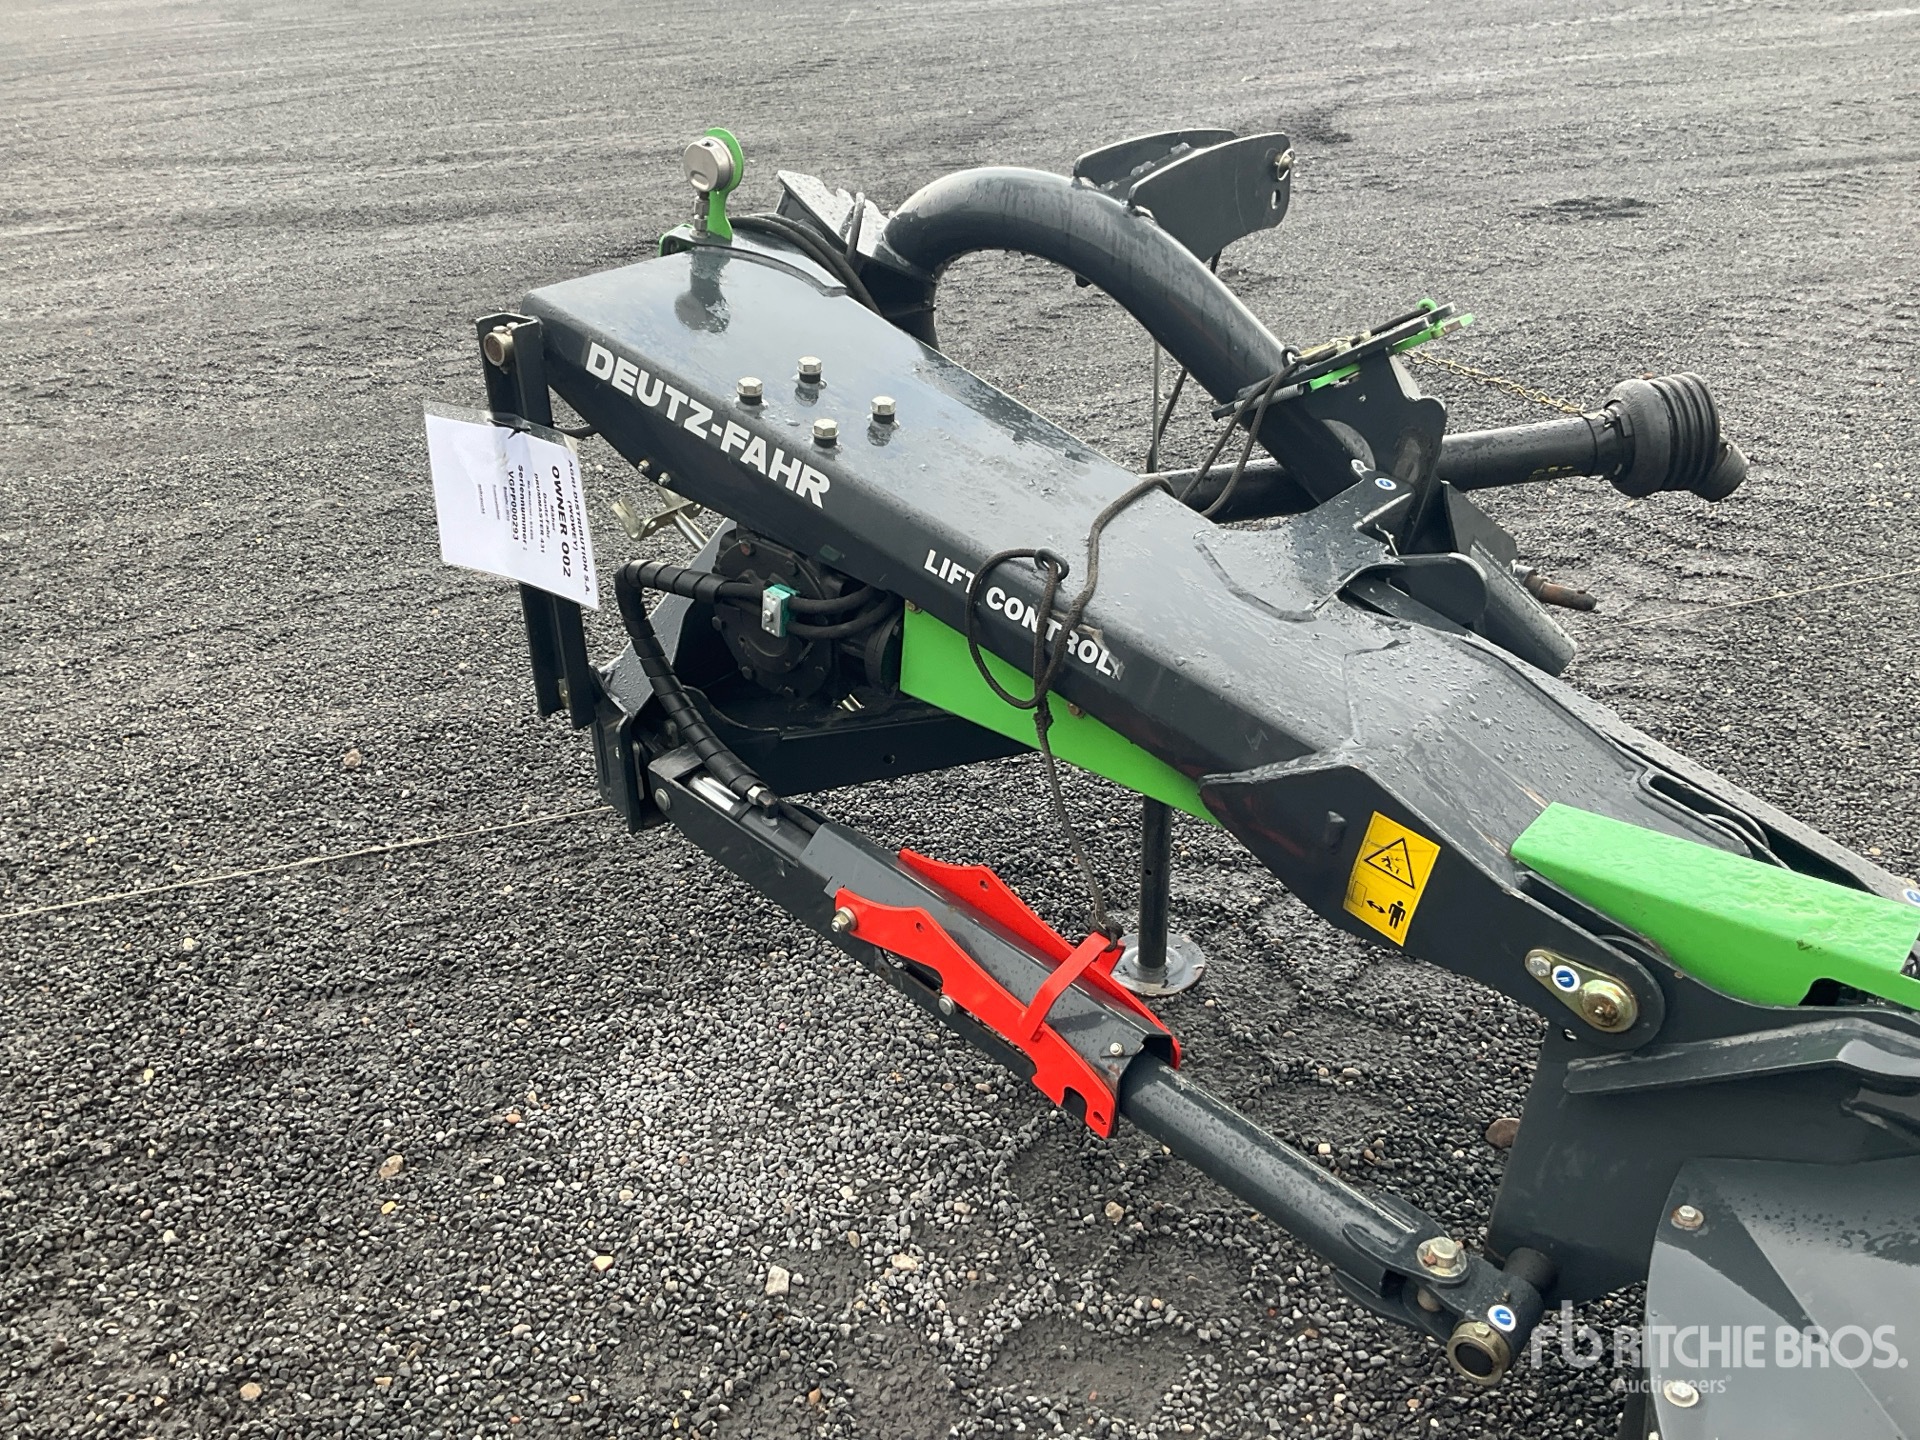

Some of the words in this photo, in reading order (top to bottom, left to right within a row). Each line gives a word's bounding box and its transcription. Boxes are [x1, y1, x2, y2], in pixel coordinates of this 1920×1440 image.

[585, 341, 830, 509] DEUTZ-FAHR
[508, 470, 519, 541] VGPP000293
[518, 464, 527, 544] Seriennummer
[552, 465, 567, 535] OWNER
[568, 459, 588, 572] AGRI-DISTRIBUTION
[924, 549, 978, 594] LIFT
[986, 587, 1113, 676] CONTROL
